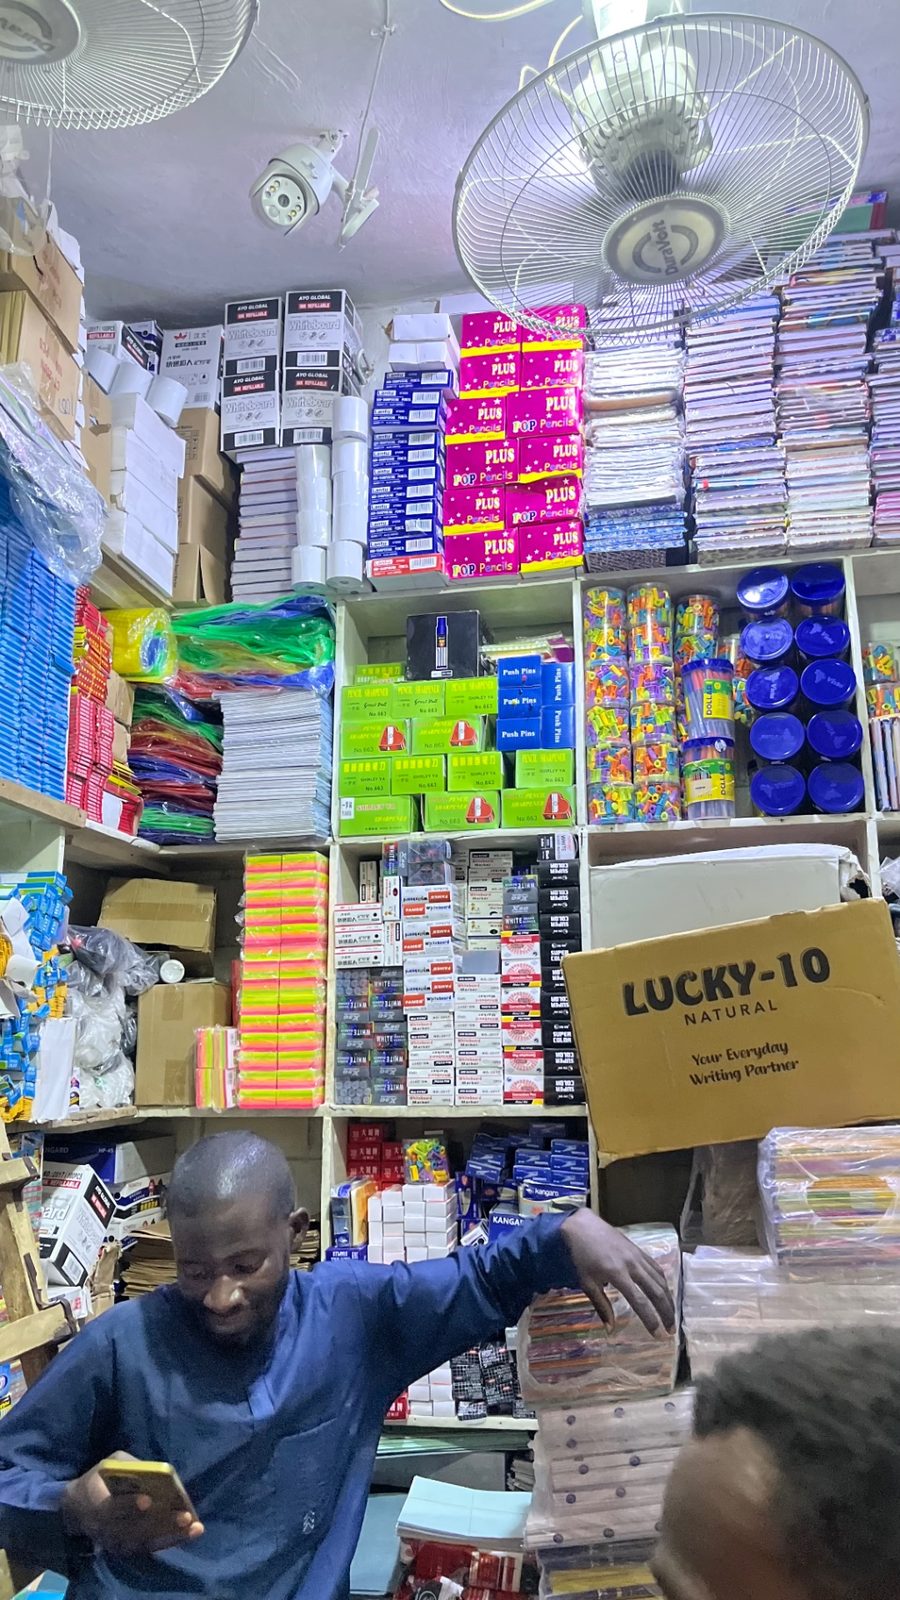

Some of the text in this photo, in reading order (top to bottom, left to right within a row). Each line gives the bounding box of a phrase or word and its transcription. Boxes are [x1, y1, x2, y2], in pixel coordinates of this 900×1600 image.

[653, 218, 680, 277] DuraVolt
[288, 318, 341, 331] Whiteboard
[493, 321, 517, 334] PLUS
[227, 327, 277, 340] Whiteboard
[484, 337, 517, 346] Pencils
[491, 362, 516, 376] PLUS
[554, 359, 578, 373] PLUS
[483, 380, 515, 388] Pencils
[225, 398, 275, 413] Whiteboard
[546, 396, 577, 412] PLUS
[478, 408, 502, 421] PLUS
[468, 425, 502, 433] Pencils
[512, 418, 575, 434] POP Pencils
[485, 448, 515, 465] PLUS
[553, 444, 578, 458] PLUS
[544, 462, 578, 471] Pencils
[453, 470, 513, 487] POP Pencils
[545, 486, 576, 504] PLUS
[475, 497, 500, 511] PLUS
[466, 514, 500, 523] Pencils
[512, 507, 575, 524] POP Pencils
[553, 531, 578, 545] PLUS
[484, 538, 515, 555] PLUS
[545, 549, 580, 559] Pencils
[452, 561, 513, 577] POP Pencils
[621, 946, 831, 1017] LUCKY-10
[684, 999, 778, 1026] NATURAL
[353, 1028, 371, 1036] WHITE
[691, 1040, 790, 1067] Your Everyday
[689, 1058, 800, 1086] Writing Partner
[535, 1188, 560, 1197] kangaro
